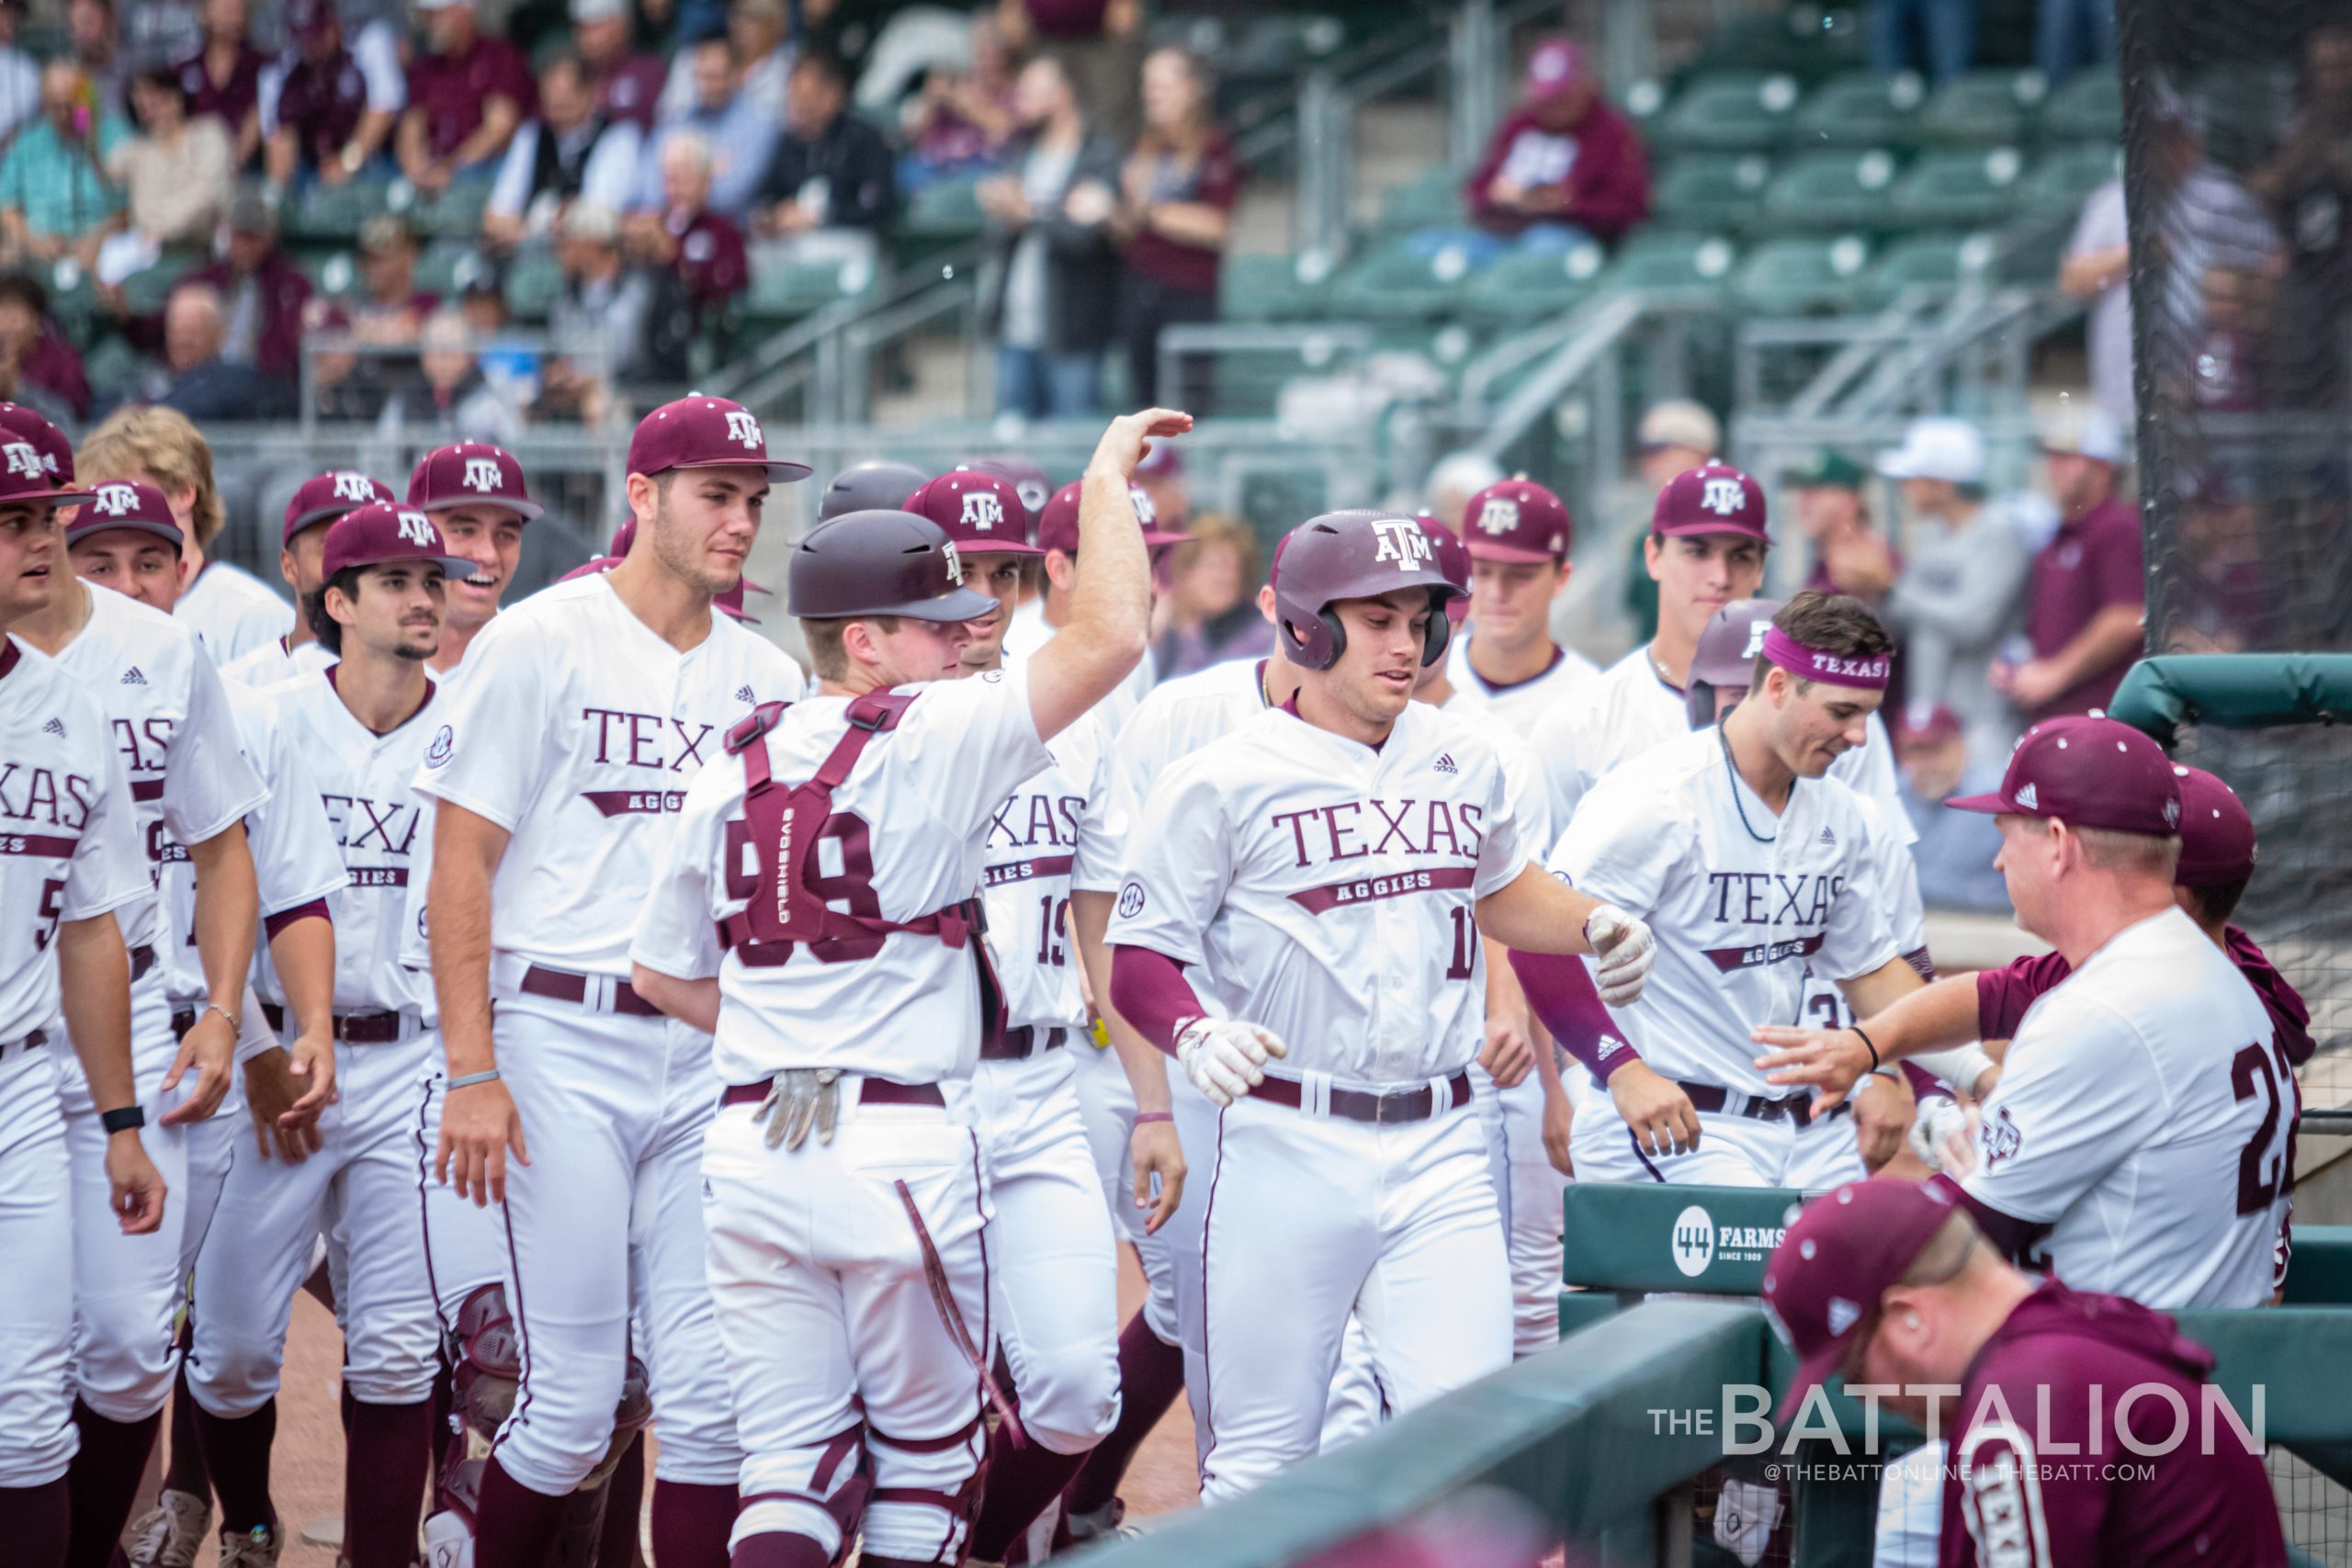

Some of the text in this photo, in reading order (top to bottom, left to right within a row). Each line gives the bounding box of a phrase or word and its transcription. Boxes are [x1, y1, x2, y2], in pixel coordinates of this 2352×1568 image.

[1812, 654, 1883, 678] TEXAS
[1272, 799, 1483, 868] TEXAS
[776, 807, 796, 925] EVOSHIELD
[1337, 874, 1432, 901] AGGIES
[1678, 1226, 1787, 1258] 44 FARMS
[1718, 1252, 1742, 1261] SINCE
